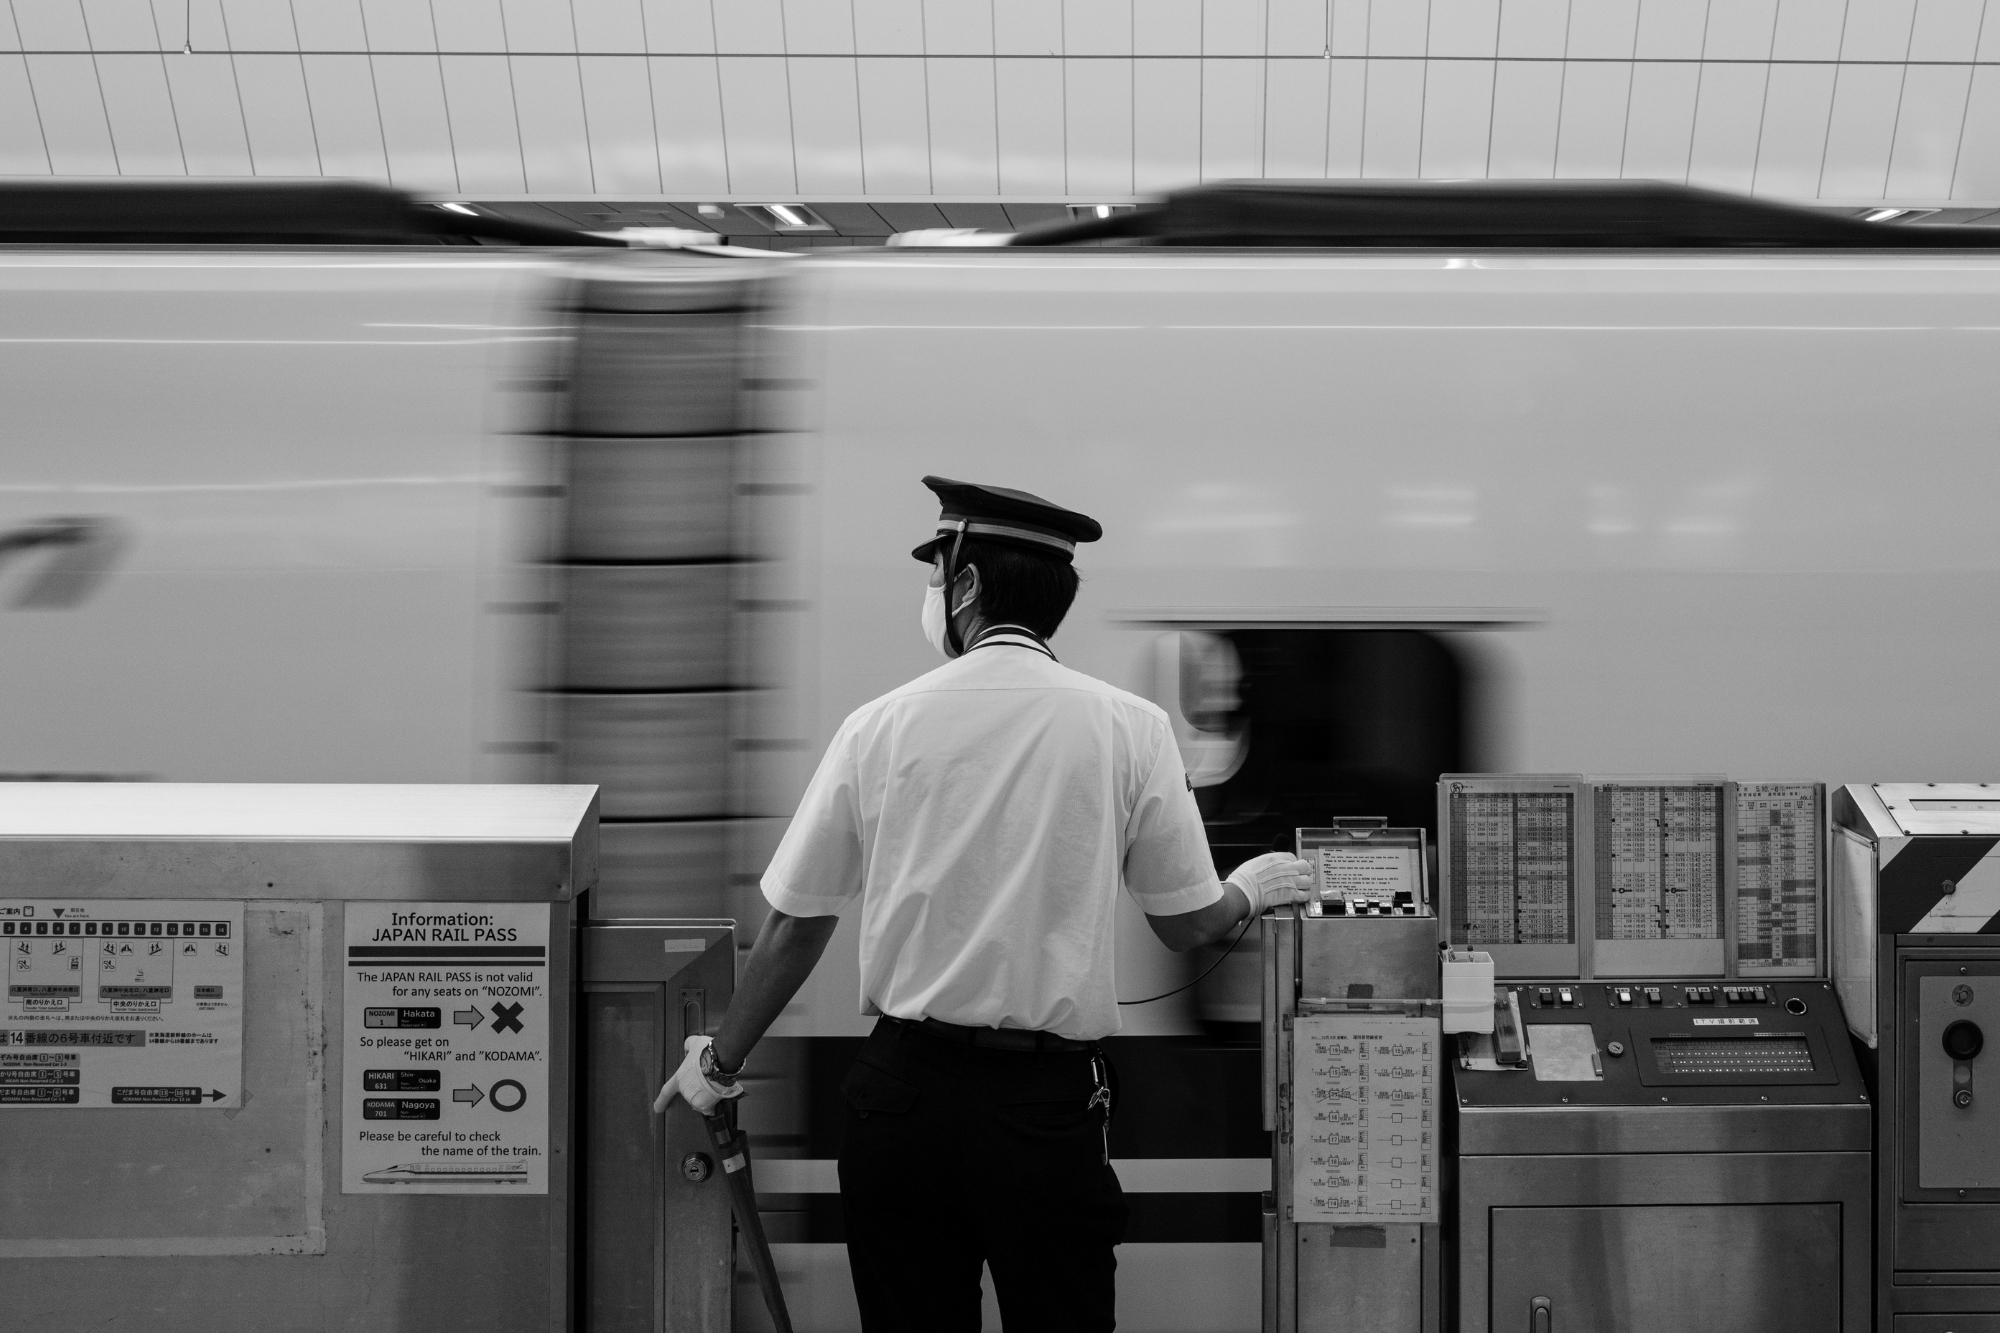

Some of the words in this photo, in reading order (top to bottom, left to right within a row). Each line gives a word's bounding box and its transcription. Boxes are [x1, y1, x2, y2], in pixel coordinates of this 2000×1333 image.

[392, 912, 493, 926] Information:
[372, 928, 426, 941] JAPAN
[432, 928, 469, 941] RAIL
[475, 928, 517, 941] PASS
[357, 972, 377, 982] The
[381, 972, 415, 982] JAPAN
[419, 972, 442, 982] RAIL
[446, 972, 471, 982] PASS
[475, 972, 482, 982] is
[486, 973, 504, 982] not
[508, 972, 533, 982] valid
[392, 986, 408, 996] for
[411, 988, 430, 998] any
[434, 987, 461, 996] seats
[360, 1037, 373, 1047] So
[377, 1037, 411, 1048] please
[415, 1038, 432, 1048] get
[455, 1051, 475, 1061] and
[360, 1131, 394, 1141] Please
[398, 1131, 411, 1141] be
[415, 1131, 451, 1141] careful
[455, 1133, 466, 1141] to
[470, 1131, 500, 1141] check
[422, 1146, 439, 1156] the
[477, 1146, 488, 1156] of
[492, 1146, 509, 1156] the
[513, 1146, 541, 1156] train.
